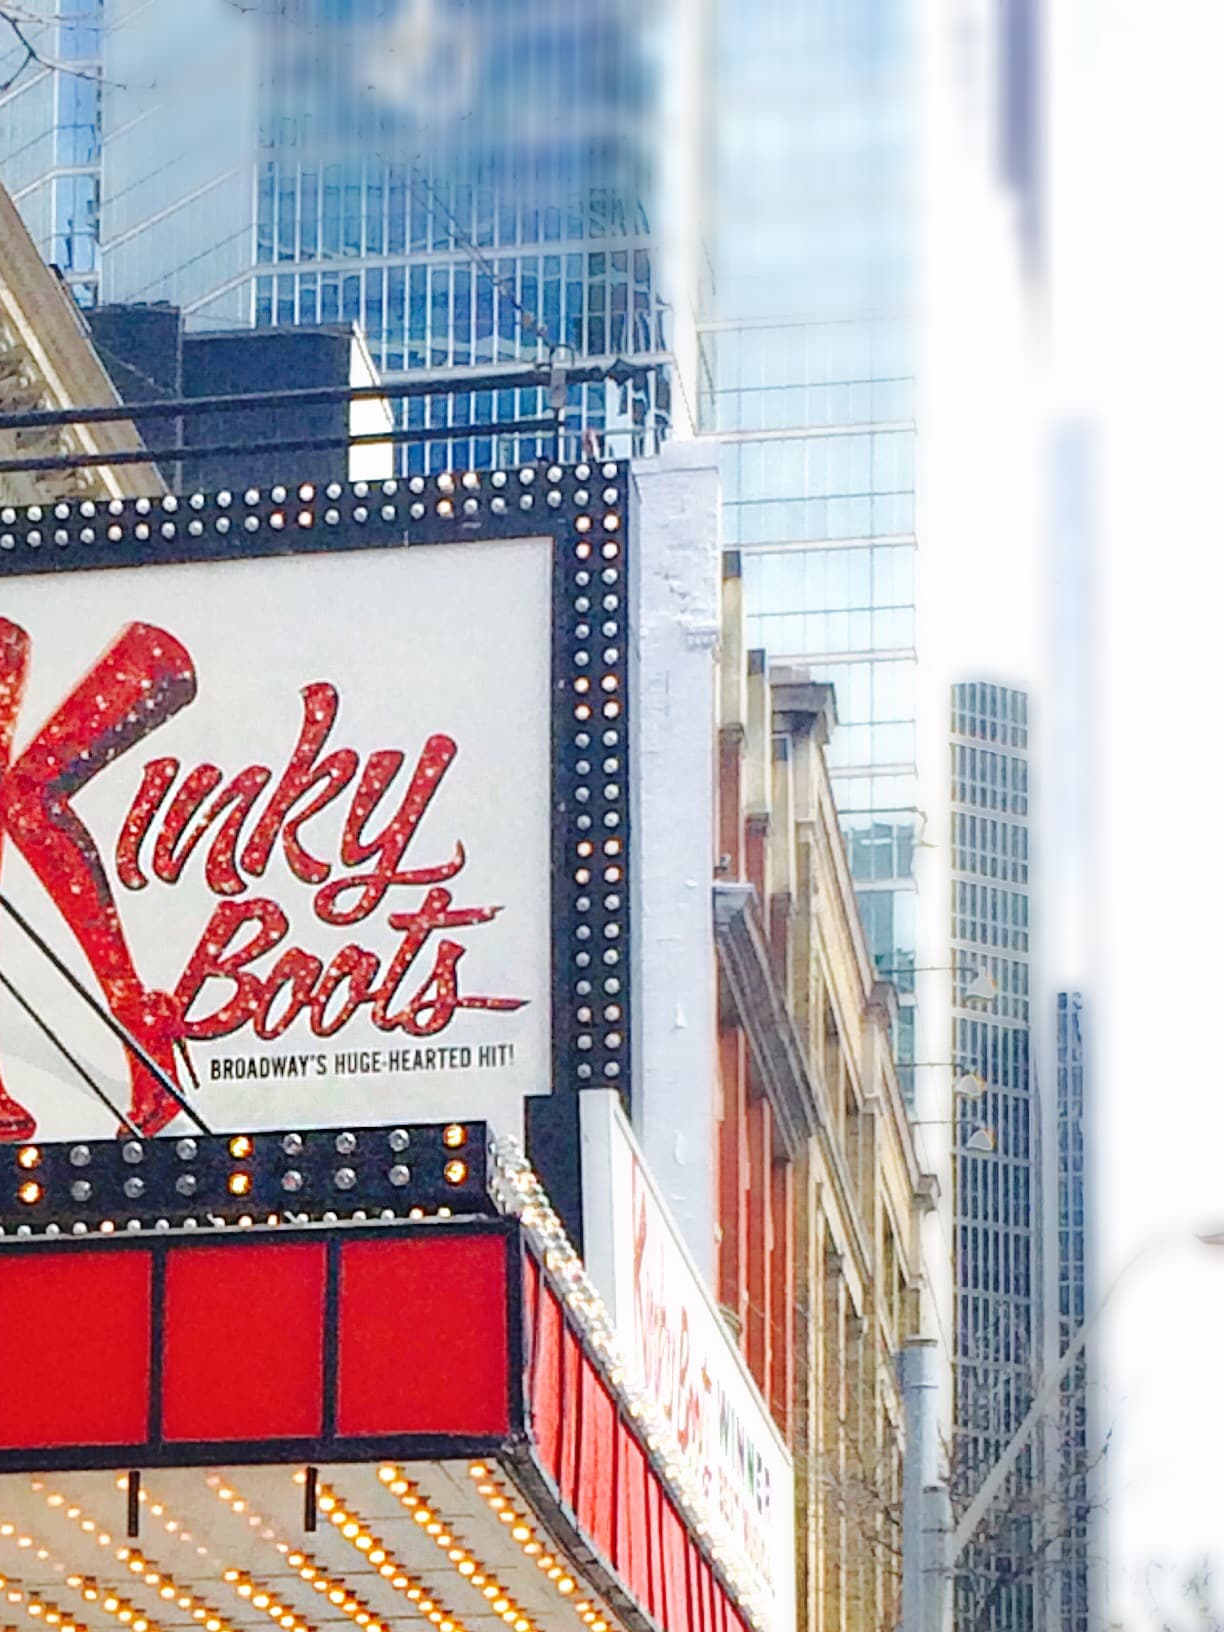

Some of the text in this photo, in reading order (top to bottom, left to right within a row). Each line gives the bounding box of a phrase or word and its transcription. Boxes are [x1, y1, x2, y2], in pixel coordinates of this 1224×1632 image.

[179, 886, 530, 1042] Boots
[210, 1043, 515, 1081] BROADWAY'S HUGE-HEARTED HIT!
